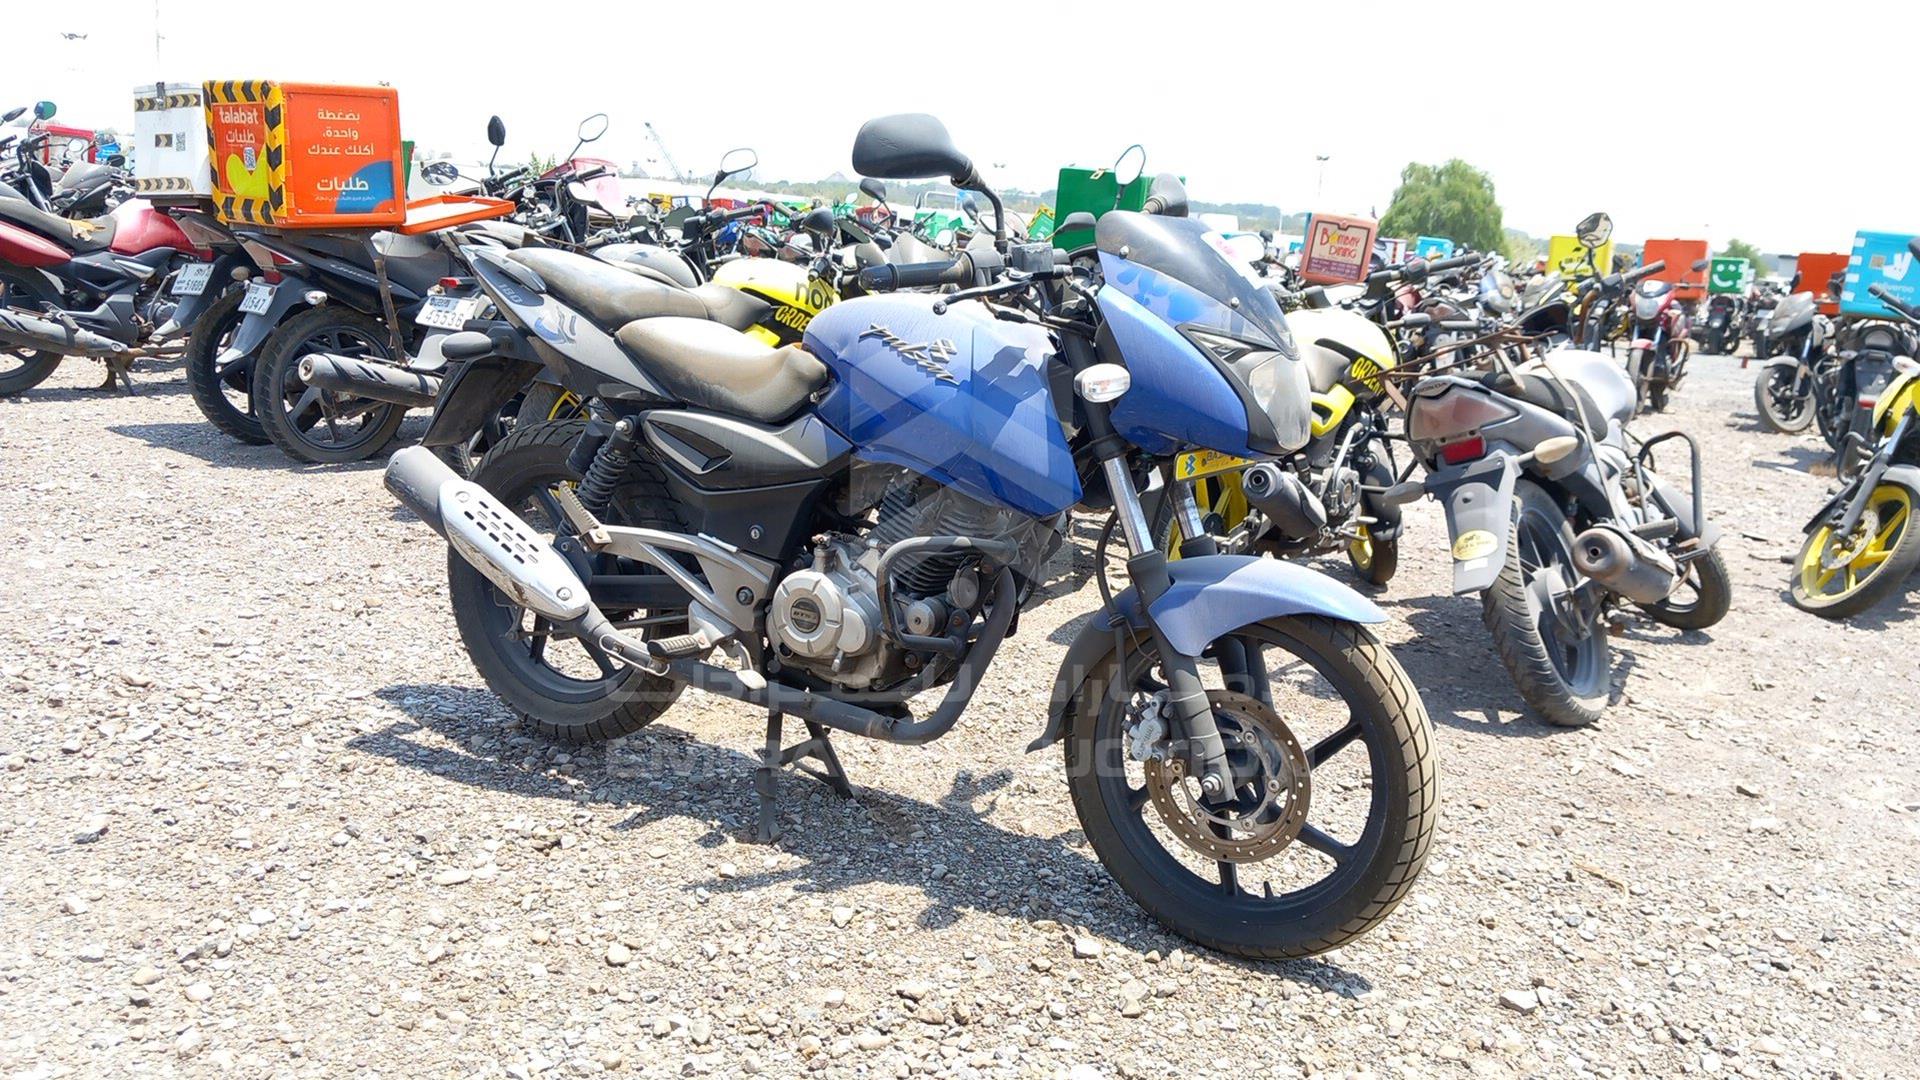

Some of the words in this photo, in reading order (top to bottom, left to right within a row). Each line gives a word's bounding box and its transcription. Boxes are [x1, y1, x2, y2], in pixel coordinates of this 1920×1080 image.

[219, 106, 259, 125] talabat
[318, 108, 360, 124] بضغطة
[225, 128, 256, 147] طلبات
[308, 144, 340, 155] عندك
[317, 176, 369, 195] طلبات
[499, 283, 523, 304] 180
